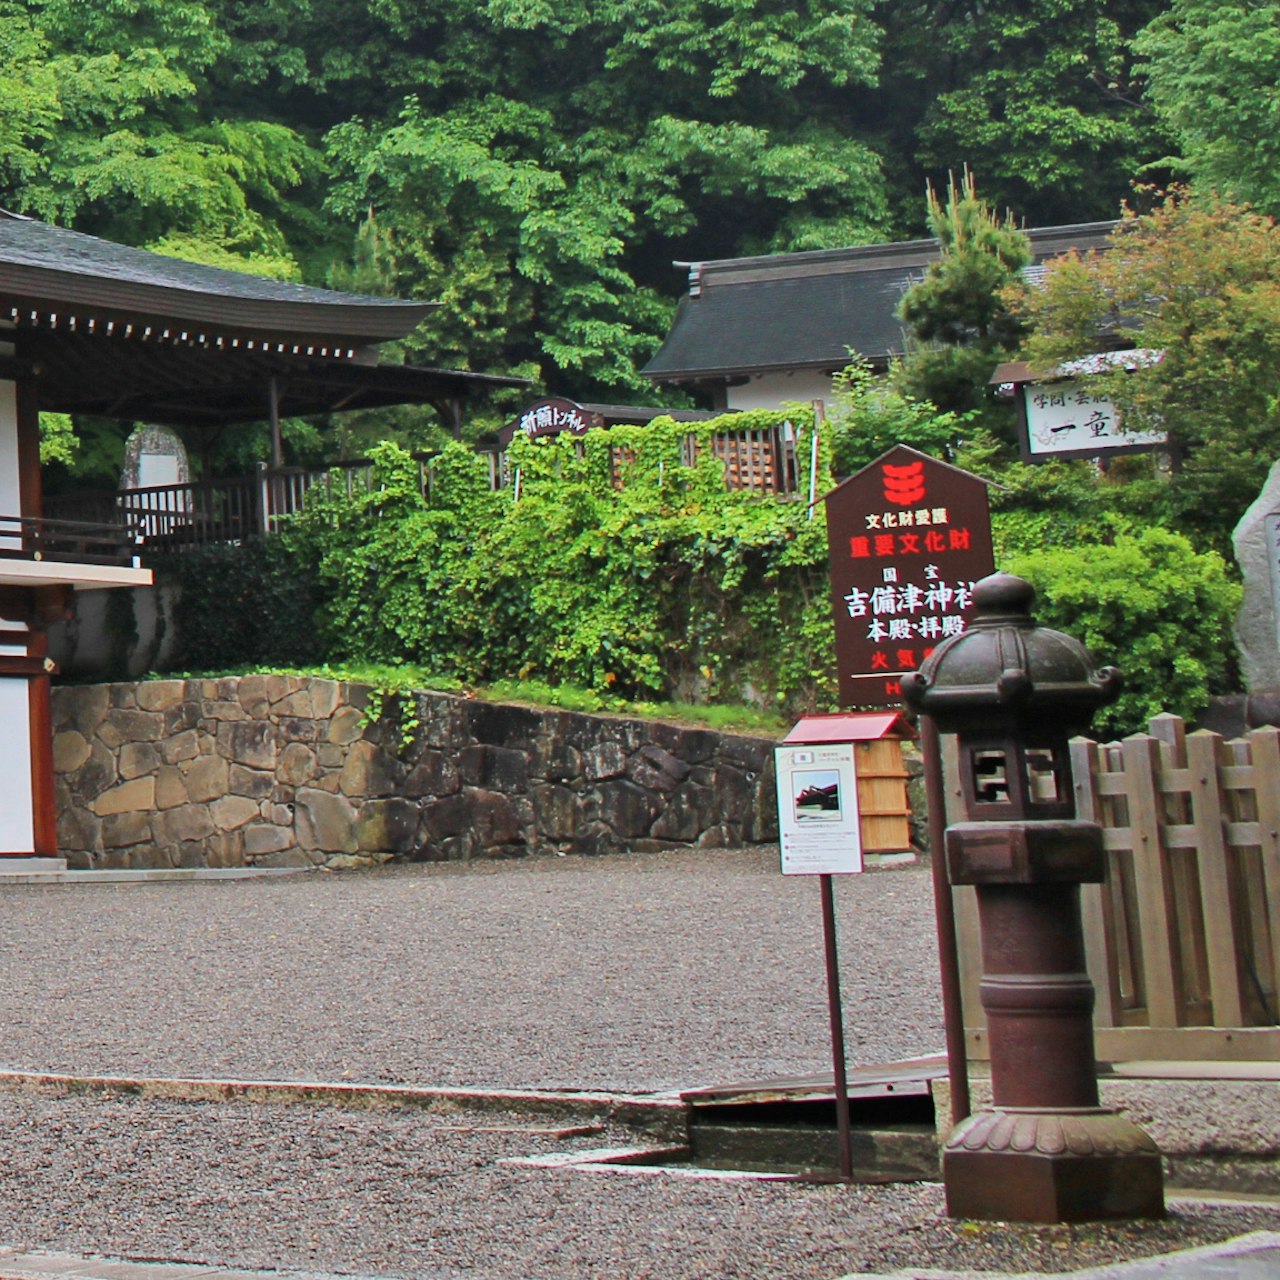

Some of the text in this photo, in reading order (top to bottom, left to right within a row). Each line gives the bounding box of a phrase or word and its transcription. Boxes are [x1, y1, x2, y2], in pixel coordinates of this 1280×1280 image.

[1050, 410, 1127, 439] 一童
[865, 508, 948, 529] 文化財愛護
[849, 528, 971, 558] 重要文化財
[844, 581, 975, 618] 吉備津神社
